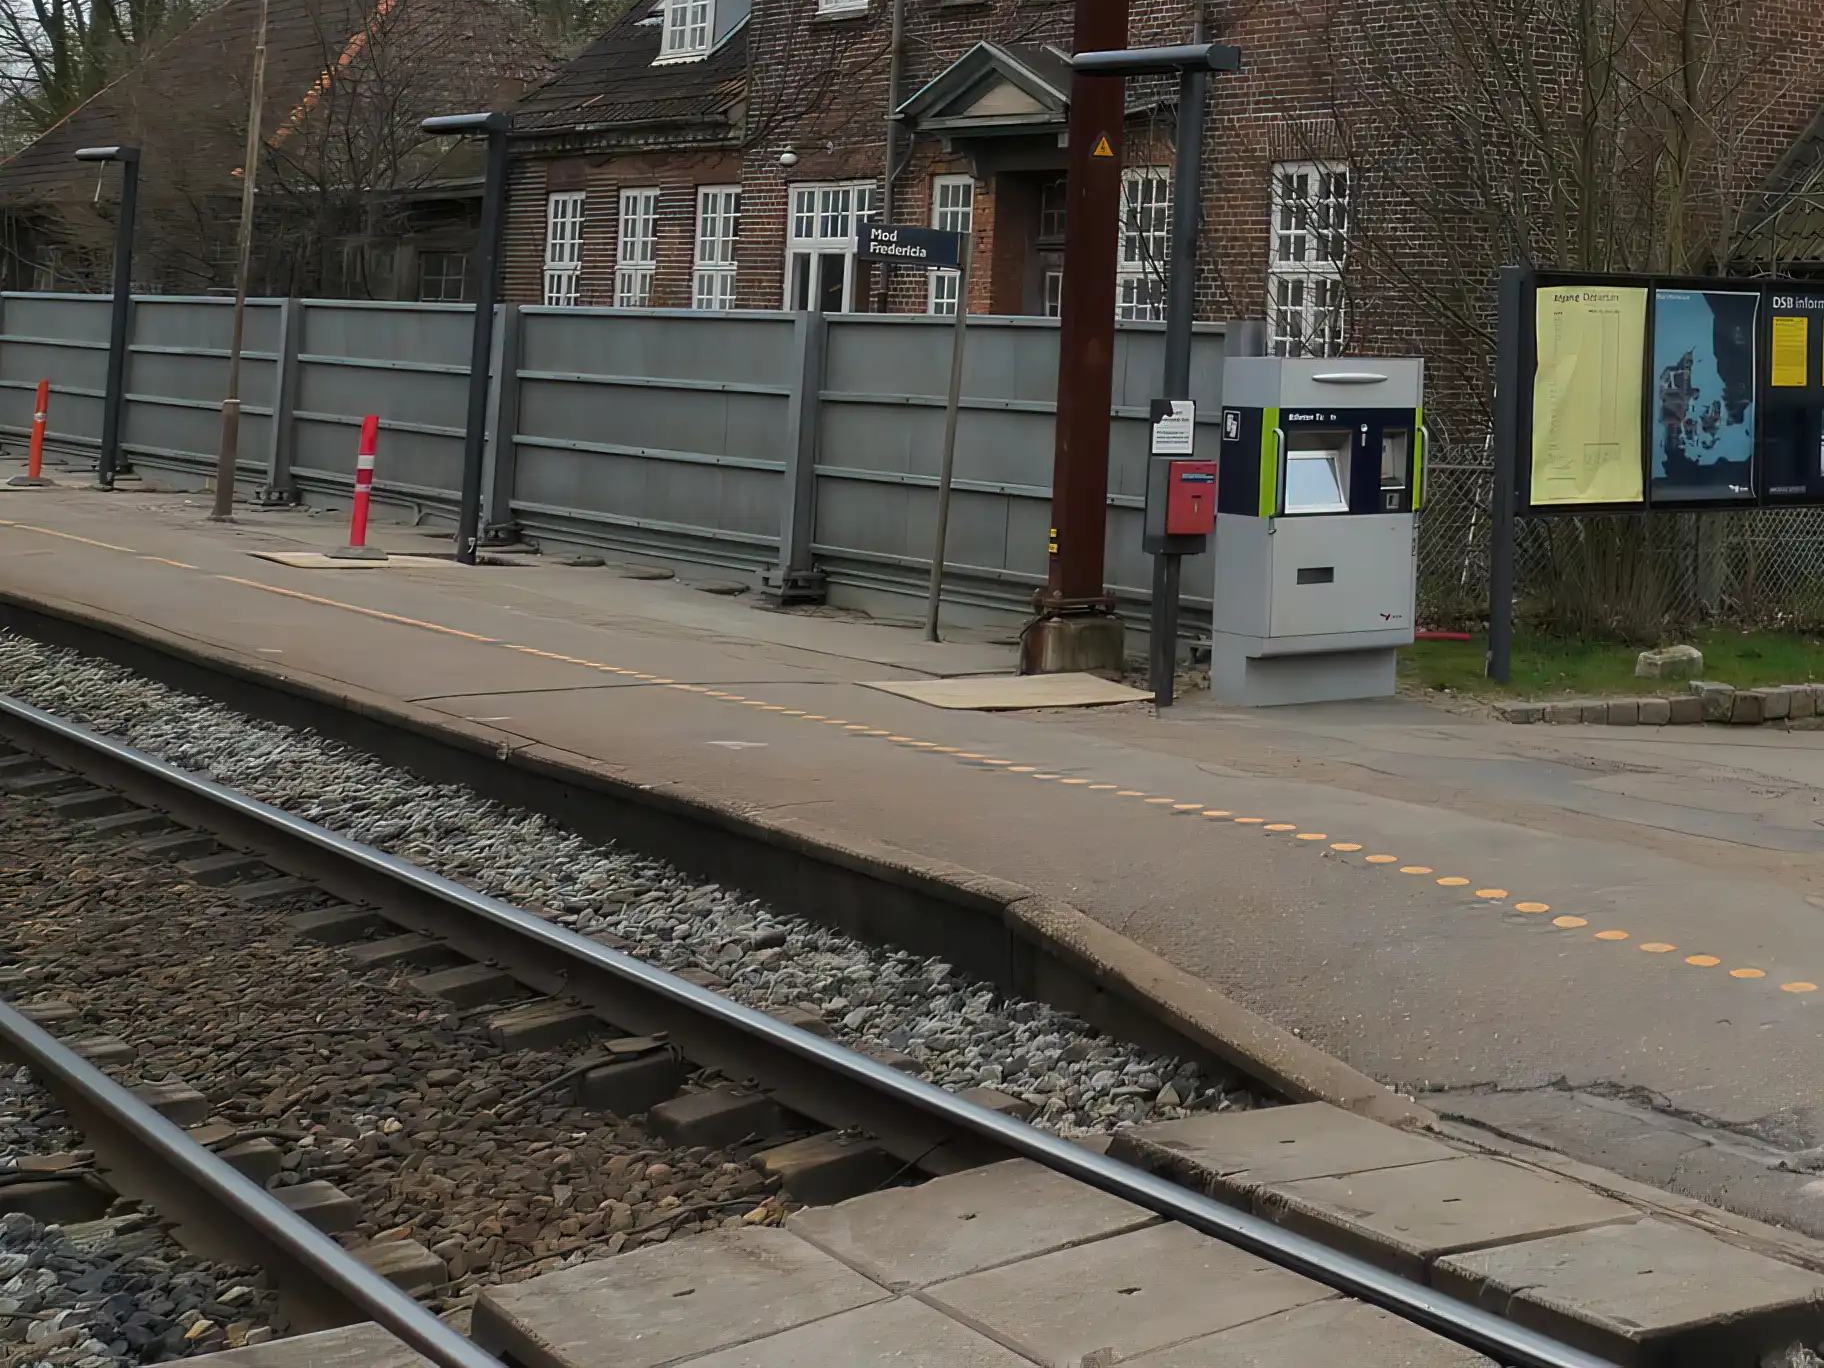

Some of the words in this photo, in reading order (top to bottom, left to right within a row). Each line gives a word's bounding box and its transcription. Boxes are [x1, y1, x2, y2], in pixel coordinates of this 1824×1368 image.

[870, 228, 898, 241] Mod
[869, 241, 927, 257] Fredericia
[1772, 296, 1794, 309] DSB
